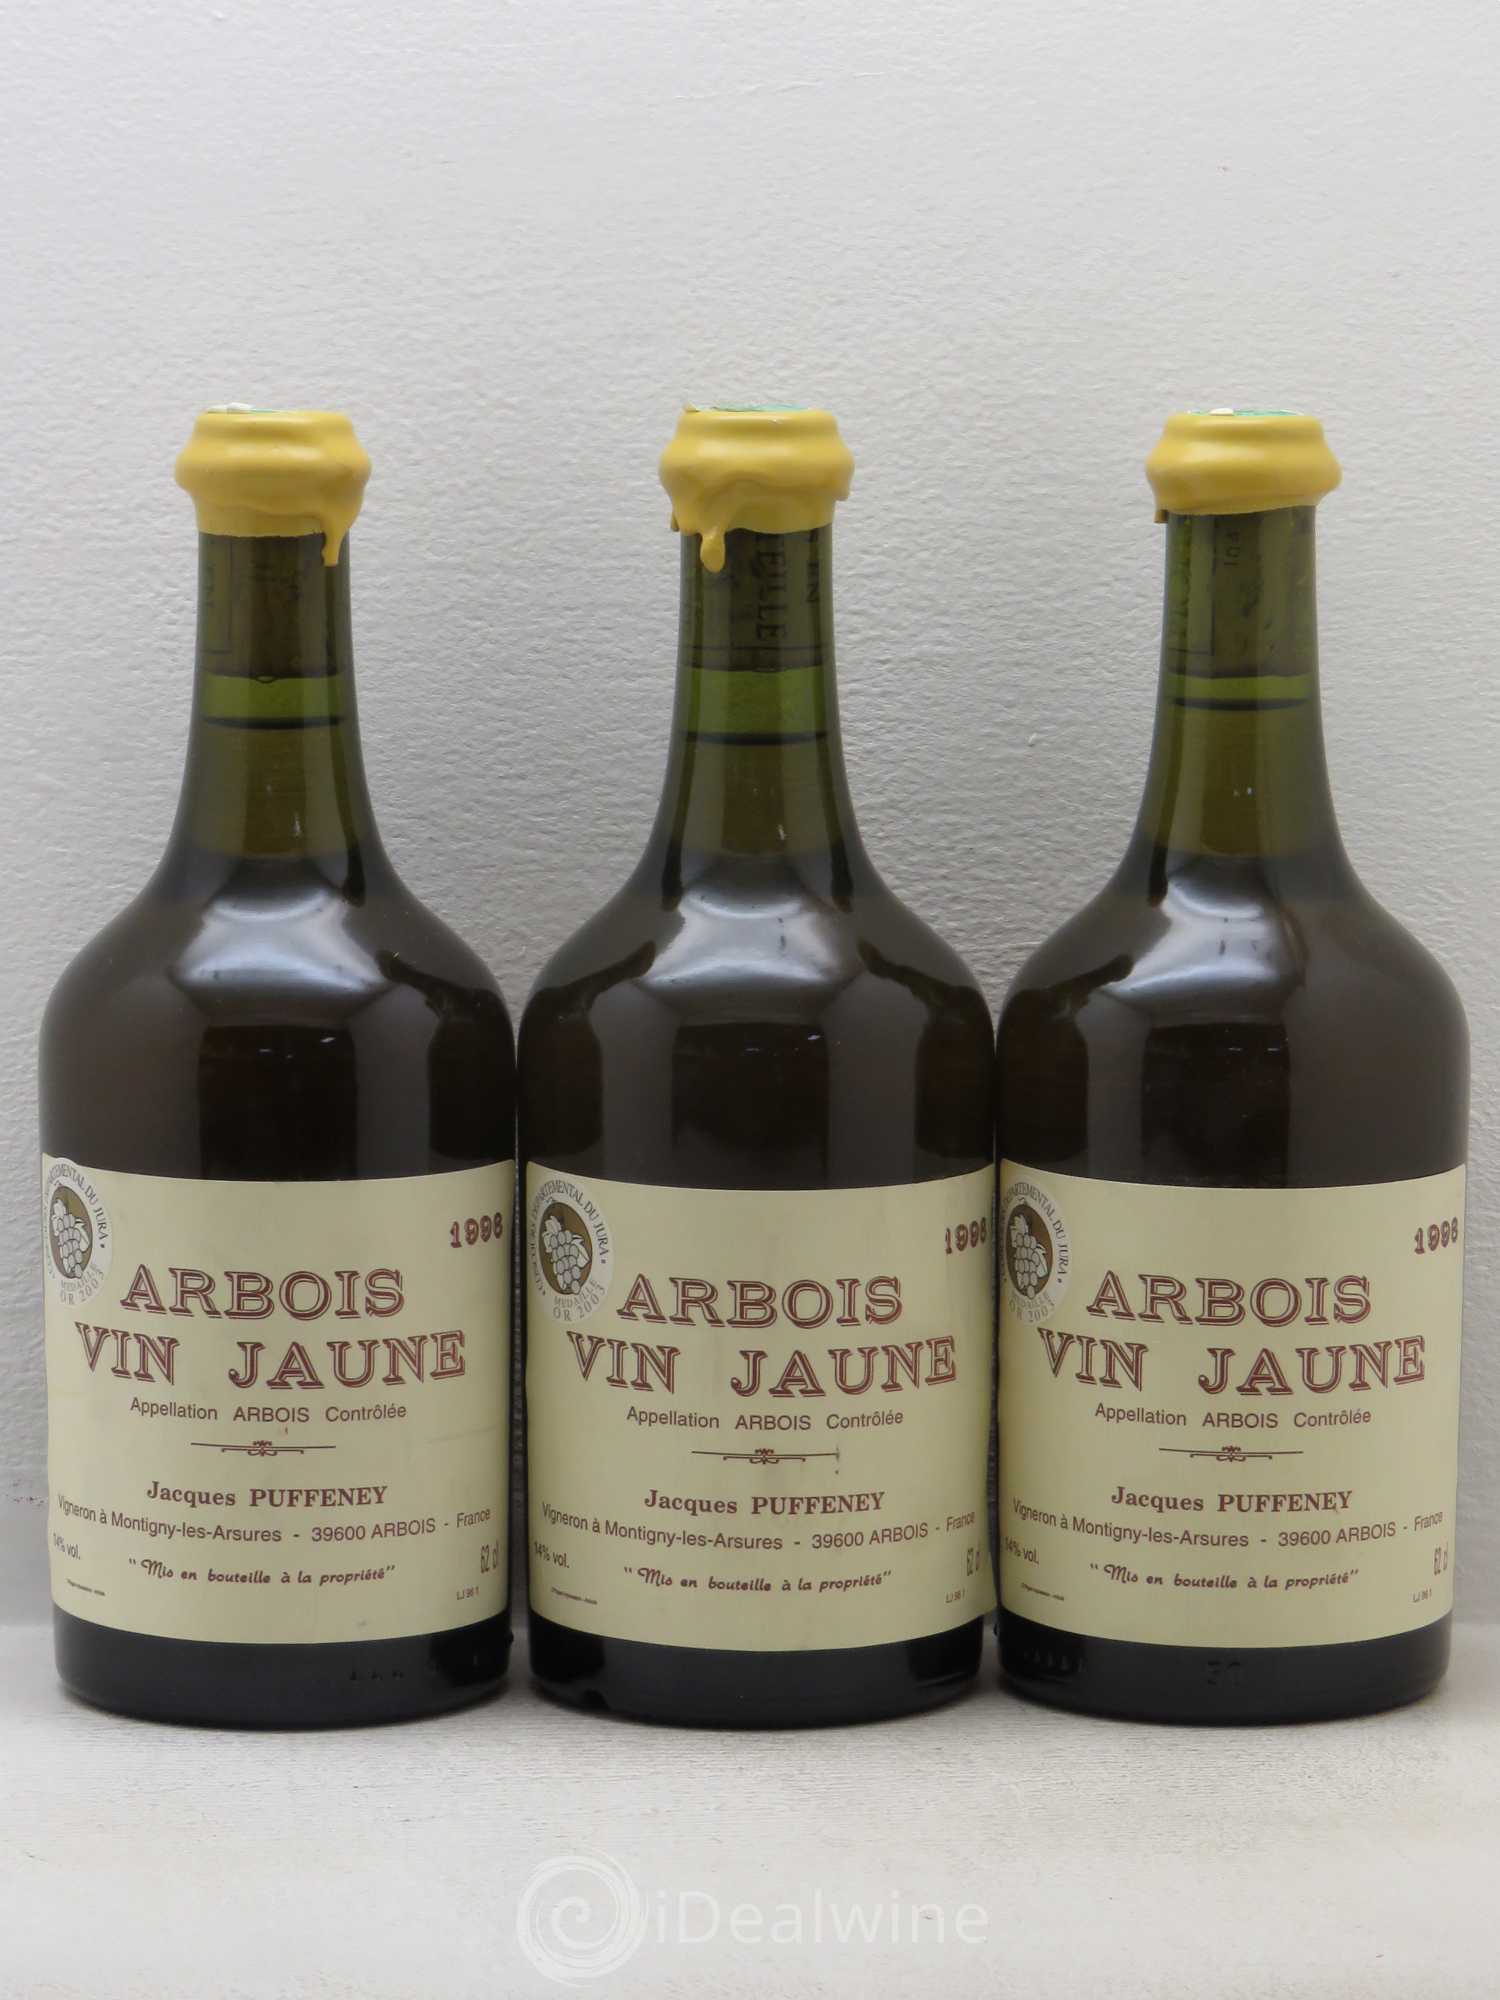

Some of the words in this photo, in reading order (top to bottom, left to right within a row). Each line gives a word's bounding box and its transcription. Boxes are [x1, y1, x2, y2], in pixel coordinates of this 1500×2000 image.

[94, 1207, 109, 1241] JURA
[583, 1201, 597, 1220] DU
[594, 1222, 609, 1256] JURA
[1056, 1243, 1069, 1275] JURA
[120, 1264, 405, 1321] ARBOIS
[617, 1273, 902, 1329] ARBOIS
[1086, 1270, 1371, 1328] ARBOIS
[553, 1308, 571, 1322] OR
[75, 1321, 180, 1386] VIN
[228, 1330, 466, 1389] JAUNE
[567, 1330, 681, 1394] VIN
[731, 1336, 956, 1397] JAUNE
[1037, 1328, 1149, 1392] VIN
[1198, 1335, 1425, 1396] JAUNE
[130, 1397, 218, 1420] Appellation
[233, 1407, 310, 1423] ARBOIS
[325, 1403, 407, 1422] Contrôlée
[627, 1406, 720, 1429] Appellation
[735, 1415, 811, 1431] ARBOIS
[826, 1409, 904, 1429] Contrôlée
[1095, 1403, 1186, 1426] Appellation
[1202, 1412, 1278, 1428] ARBOIS
[1294, 1408, 1371, 1428] Contrôlée
[147, 1481, 236, 1507] Jacques
[250, 1486, 388, 1508] PUFFENEY
[644, 1489, 737, 1517] Jacques
[751, 1492, 885, 1515] PUFFENEY
[1111, 1486, 1203, 1513] Jacques
[1218, 1490, 1352, 1513] PUFFENEY
[57, 1494, 96, 1522] Vigneron
[100, 1510, 107, 1524] à
[111, 1511, 282, 1542] Montigny-les-Arsures
[311, 1525, 366, 1542] 39600
[371, 1518, 436, 1538] ARBOIS
[456, 1508, 491, 1529] France
[542, 1502, 588, 1531] Vigneron
[592, 1518, 600, 1533] à
[605, 1520, 783, 1551] Montigny-les-Arsures
[812, 1532, 864, 1550] 39600
[869, 1522, 928, 1545] ARBOIS
[946, 1511, 976, 1532] France
[1012, 1500, 1056, 1528] Vigneron
[1060, 1514, 1068, 1529] à
[1073, 1517, 1249, 1548] Montigny-les-Arsures
[1278, 1530, 1331, 1548] 39600
[1335, 1522, 1396, 1544] ARBOIS
[1414, 1511, 1443, 1531] France
[181, 1571, 197, 1581] en
[208, 1569, 270, 1584] bouteille
[281, 1571, 290, 1583] à
[298, 1571, 311, 1583] la
[681, 1578, 698, 1588] en
[708, 1577, 771, 1592] bouteille
[782, 1579, 790, 1591] à
[798, 1578, 812, 1591] la
[1146, 1574, 1163, 1585] en
[1174, 1573, 1237, 1588] bouteille
[1248, 1576, 1257, 1589] à
[1263, 1576, 1278, 1588] la
